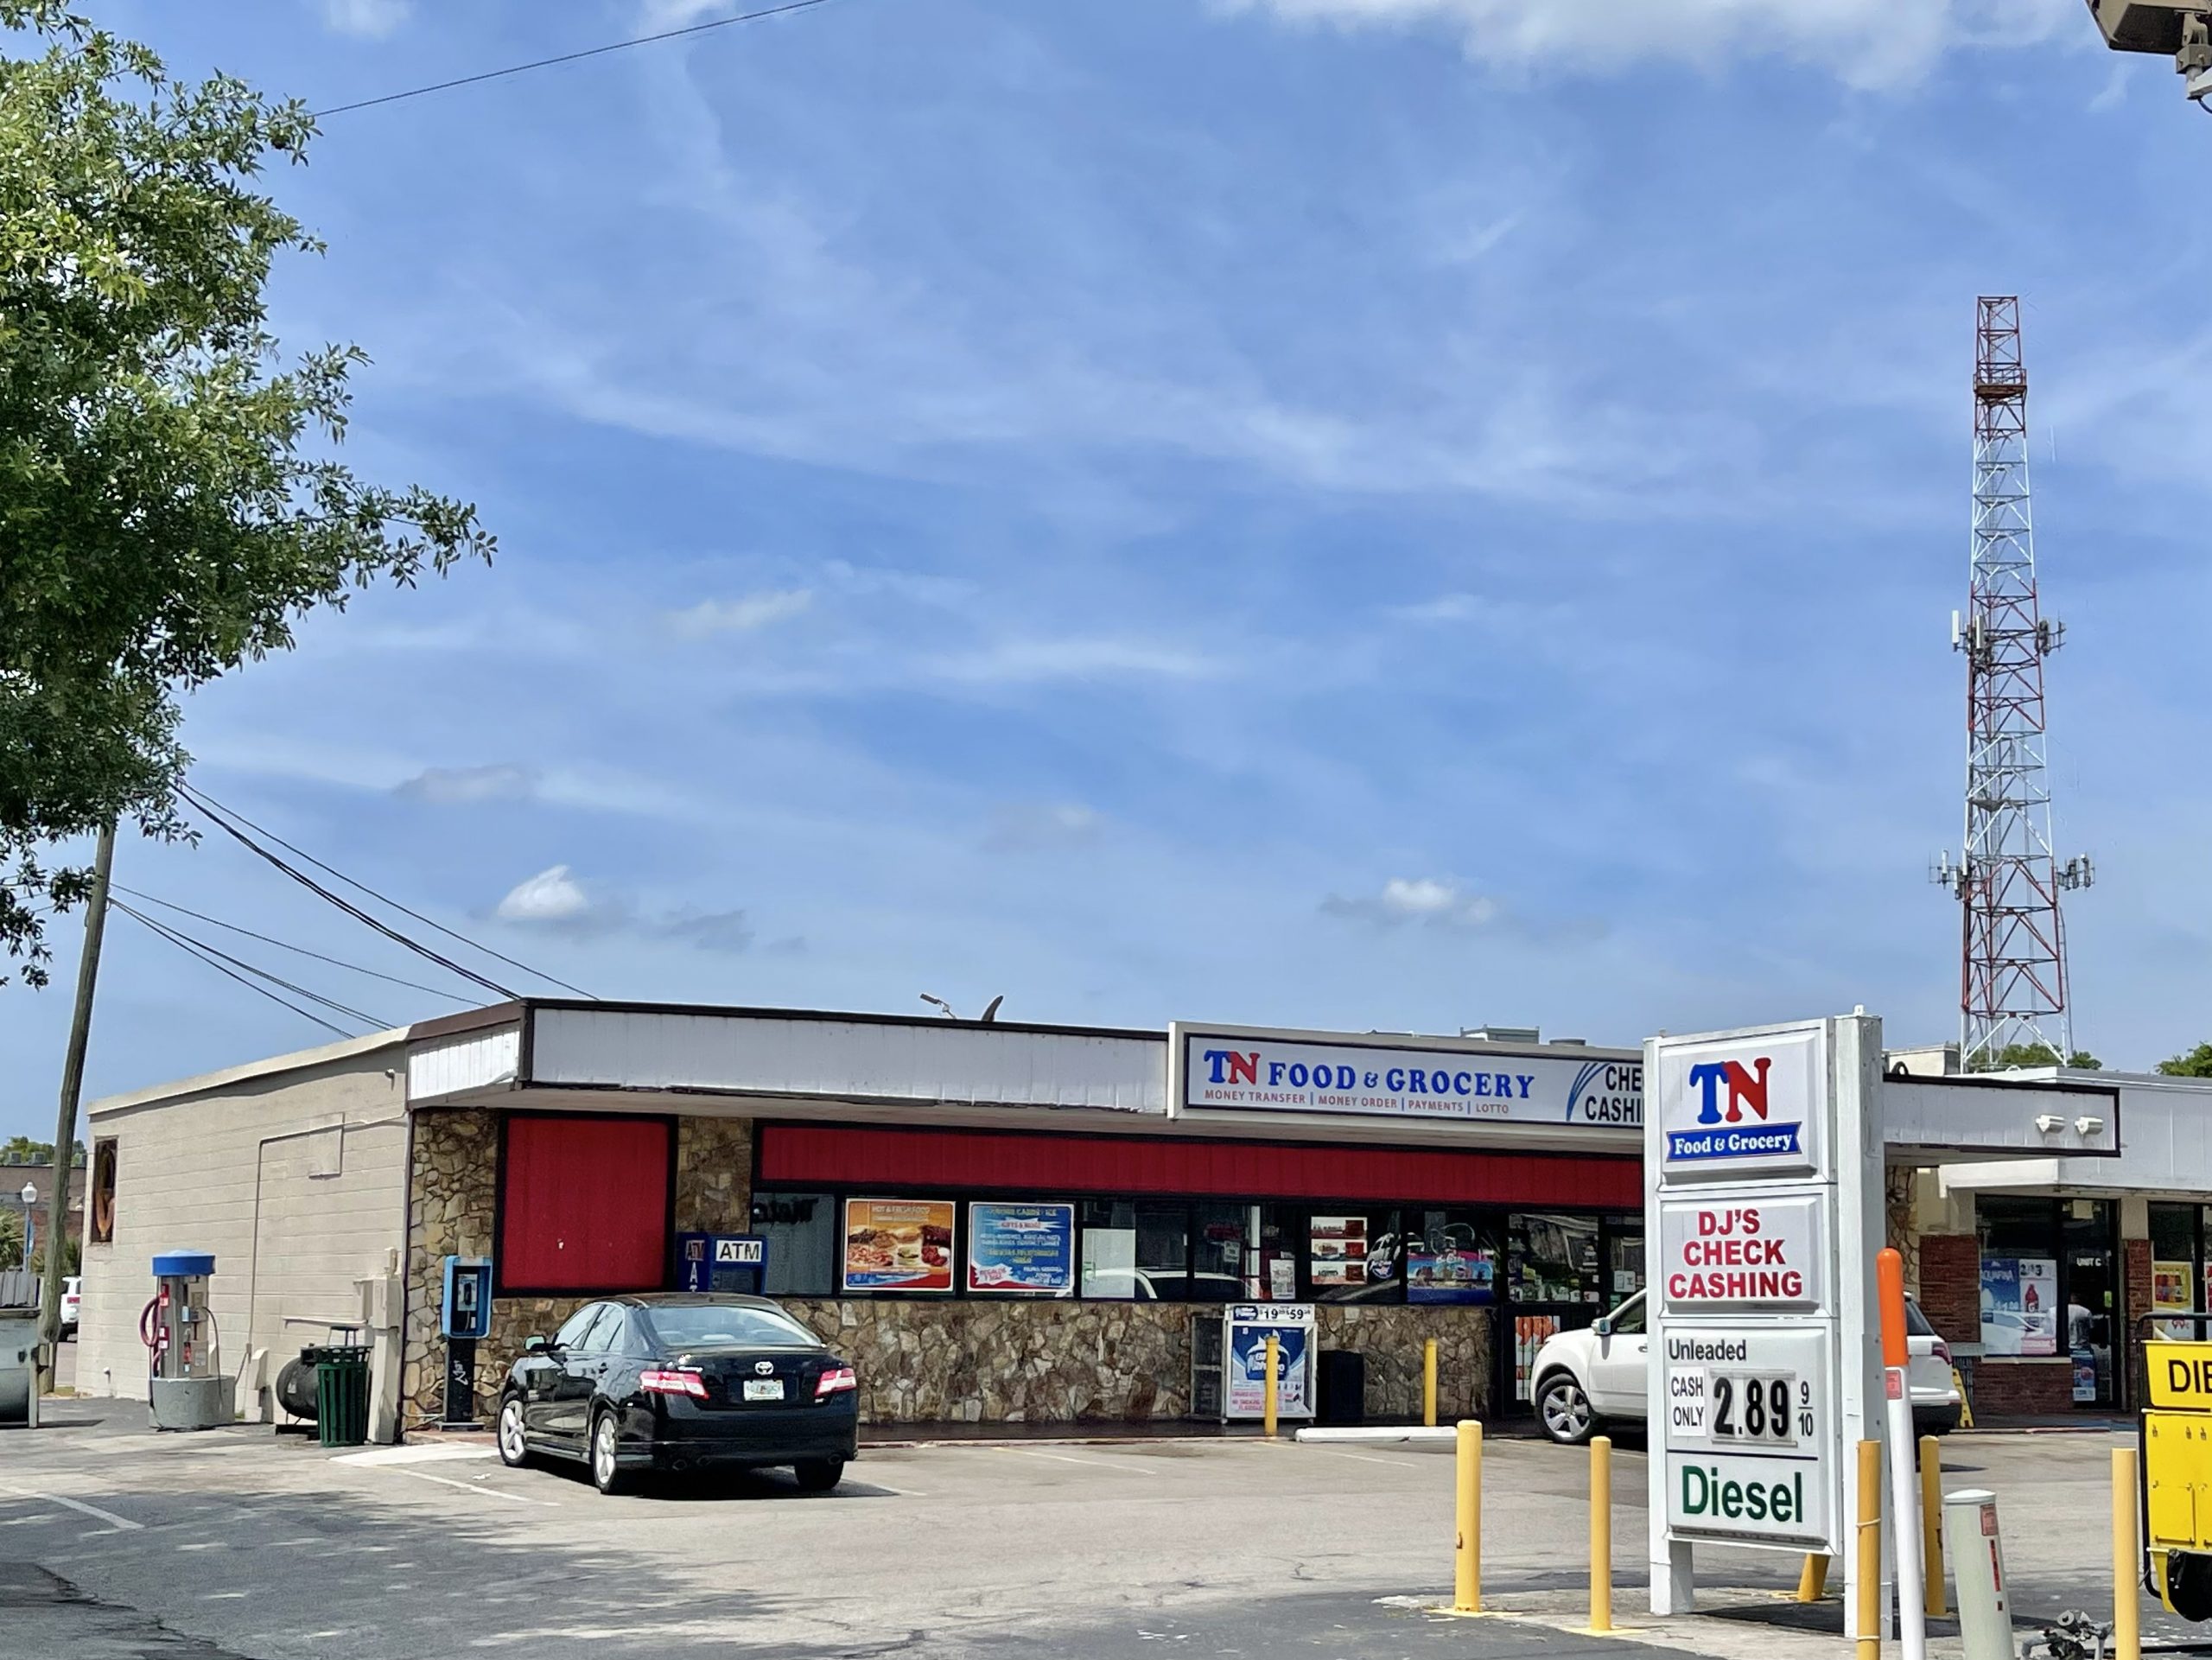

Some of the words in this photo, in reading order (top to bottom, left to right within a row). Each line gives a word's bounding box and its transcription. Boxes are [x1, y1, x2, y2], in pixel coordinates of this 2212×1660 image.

[1204, 1050, 1260, 1085] TN
[1268, 1062, 1356, 1090] FOOD
[1363, 1072, 1378, 1088] &
[1386, 1068, 1535, 1099] GROCERY
[1605, 1065, 1644, 1092] CHE
[1205, 1090, 1245, 1101] MONEY
[1249, 1091, 1306, 1103] TRANSFER
[1319, 1095, 1358, 1106] MONEY
[1361, 1097, 1397, 1109] ORDER
[1689, 1057, 1771, 1124] TN
[1408, 1099, 1464, 1111] PAYMENTS
[1476, 1103, 1510, 1114] LOTTO
[1585, 1095, 1644, 1123] CASHI
[1675, 1136, 1712, 1154] Food
[1714, 1138, 1726, 1151] &
[1729, 1134, 1793, 1153] Grocery
[1699, 1209, 1760, 1236] DJ'S
[719, 1243, 760, 1260] ATM
[1683, 1239, 1786, 1266] CHECK
[2076, 1257, 2094, 1267] UNIT
[2095, 1257, 2102, 1267] C
[1669, 1270, 1802, 1299] CASHING
[1669, 1339, 1746, 1361] Unleaded
[1671, 1377, 1704, 1397] CASH
[1801, 1381, 1810, 1405] 9
[1673, 1406, 1705, 1427] ONLY
[1713, 1377, 1789, 1437] 2.89
[1798, 1412, 1814, 1437] 10
[1682, 1466, 1803, 1523] Diesel
